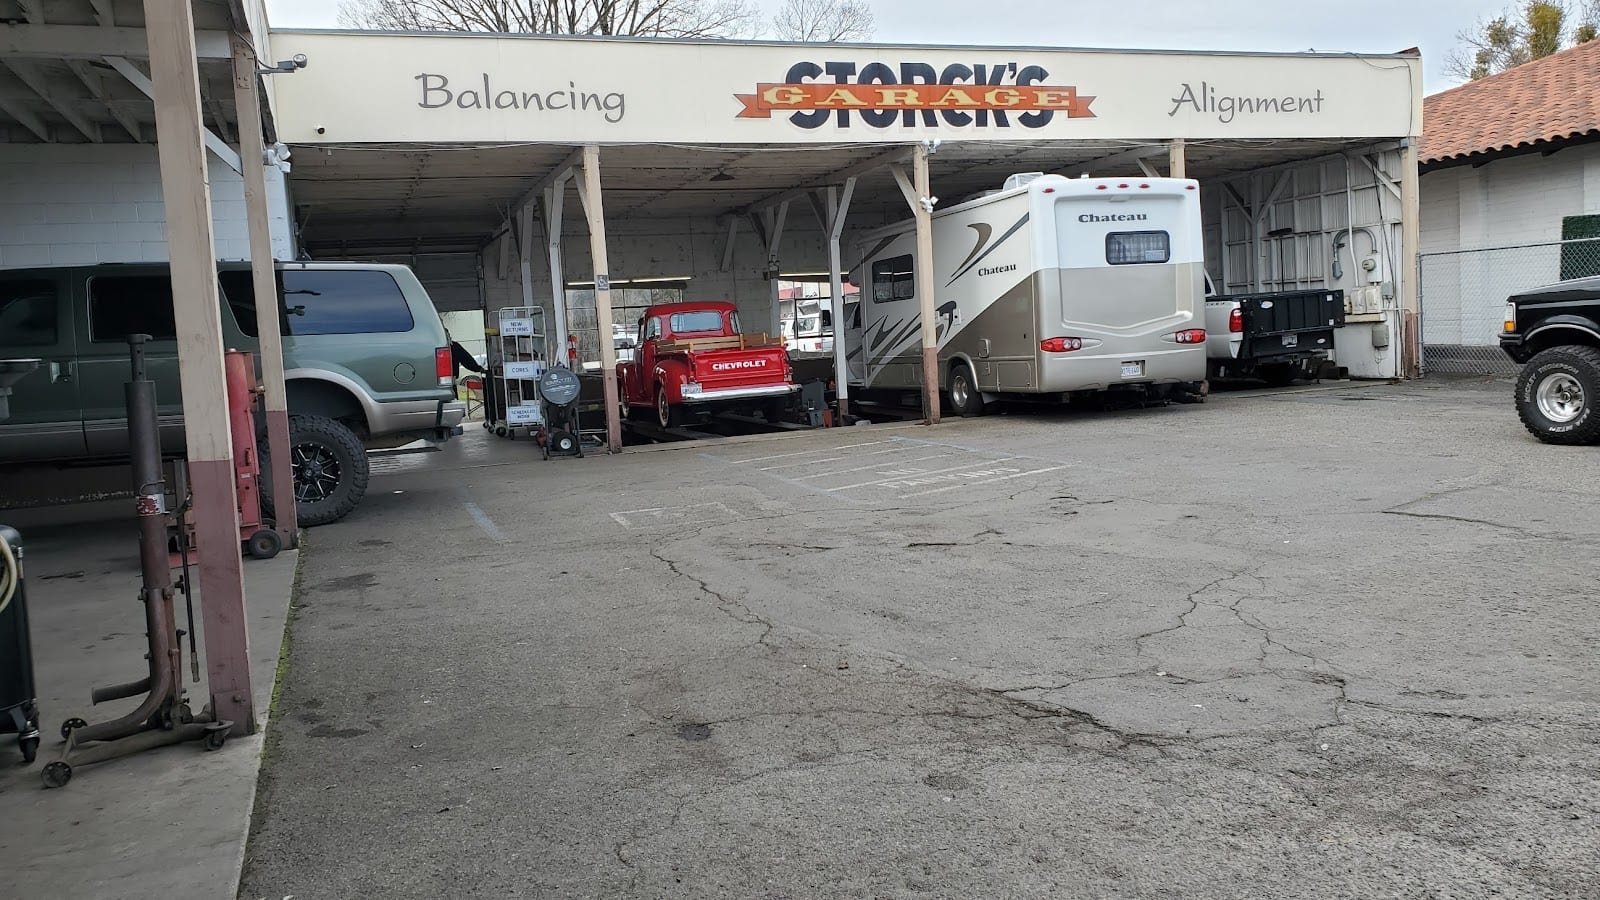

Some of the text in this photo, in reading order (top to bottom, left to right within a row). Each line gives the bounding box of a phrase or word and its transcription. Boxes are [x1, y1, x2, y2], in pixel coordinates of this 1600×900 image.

[414, 72, 625, 123] Balancing
[762, 85, 1070, 108] GARAGE
[785, 61, 1055, 129] STORCK'S
[1168, 81, 1325, 124] Alignment
[1078, 213, 1148, 223] Chateau
[978, 263, 1017, 277] Chateau
[712, 359, 767, 370] CHEVROLET
